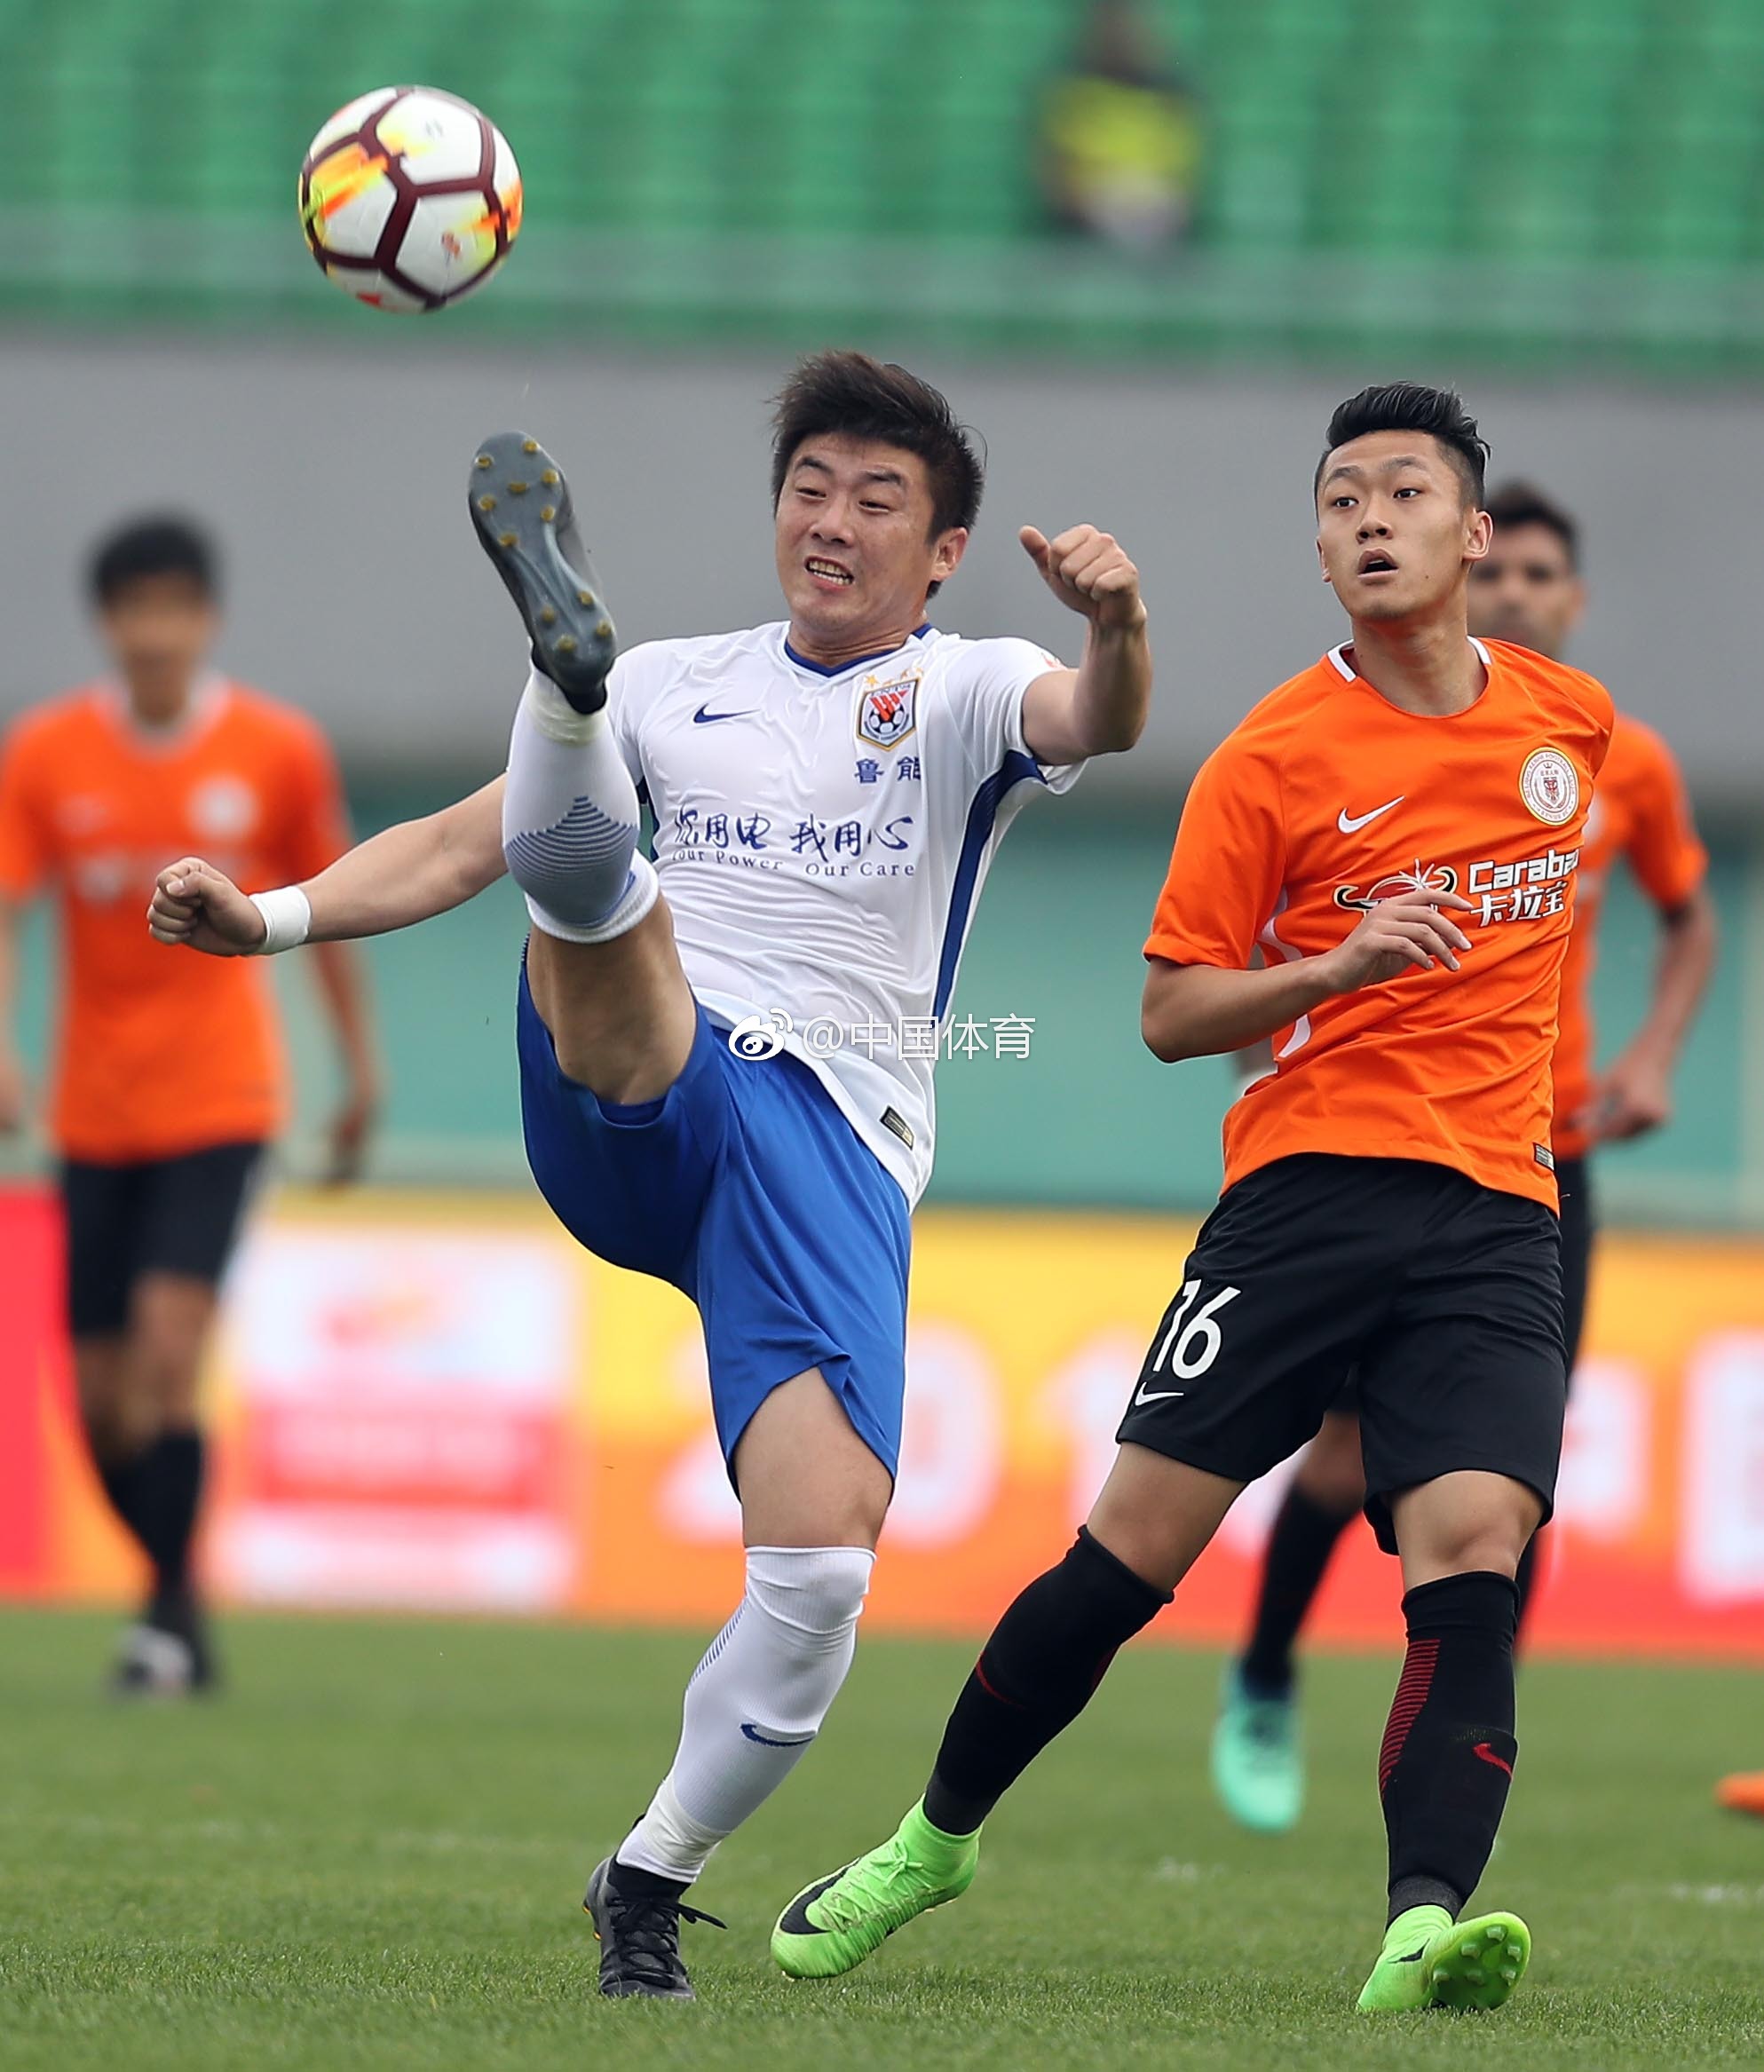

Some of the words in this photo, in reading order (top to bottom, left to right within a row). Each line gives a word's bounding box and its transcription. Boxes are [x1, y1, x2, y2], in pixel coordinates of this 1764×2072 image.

[854, 755, 922, 783] 鲁能
[788, 813, 914, 863] 我用心
[716, 850, 783, 870] Power
[805, 862, 850, 877] Our
[859, 861, 915, 877] Care
[1470, 880, 1568, 928] 卡拉宝
[1152, 1278, 1242, 1380] 16
